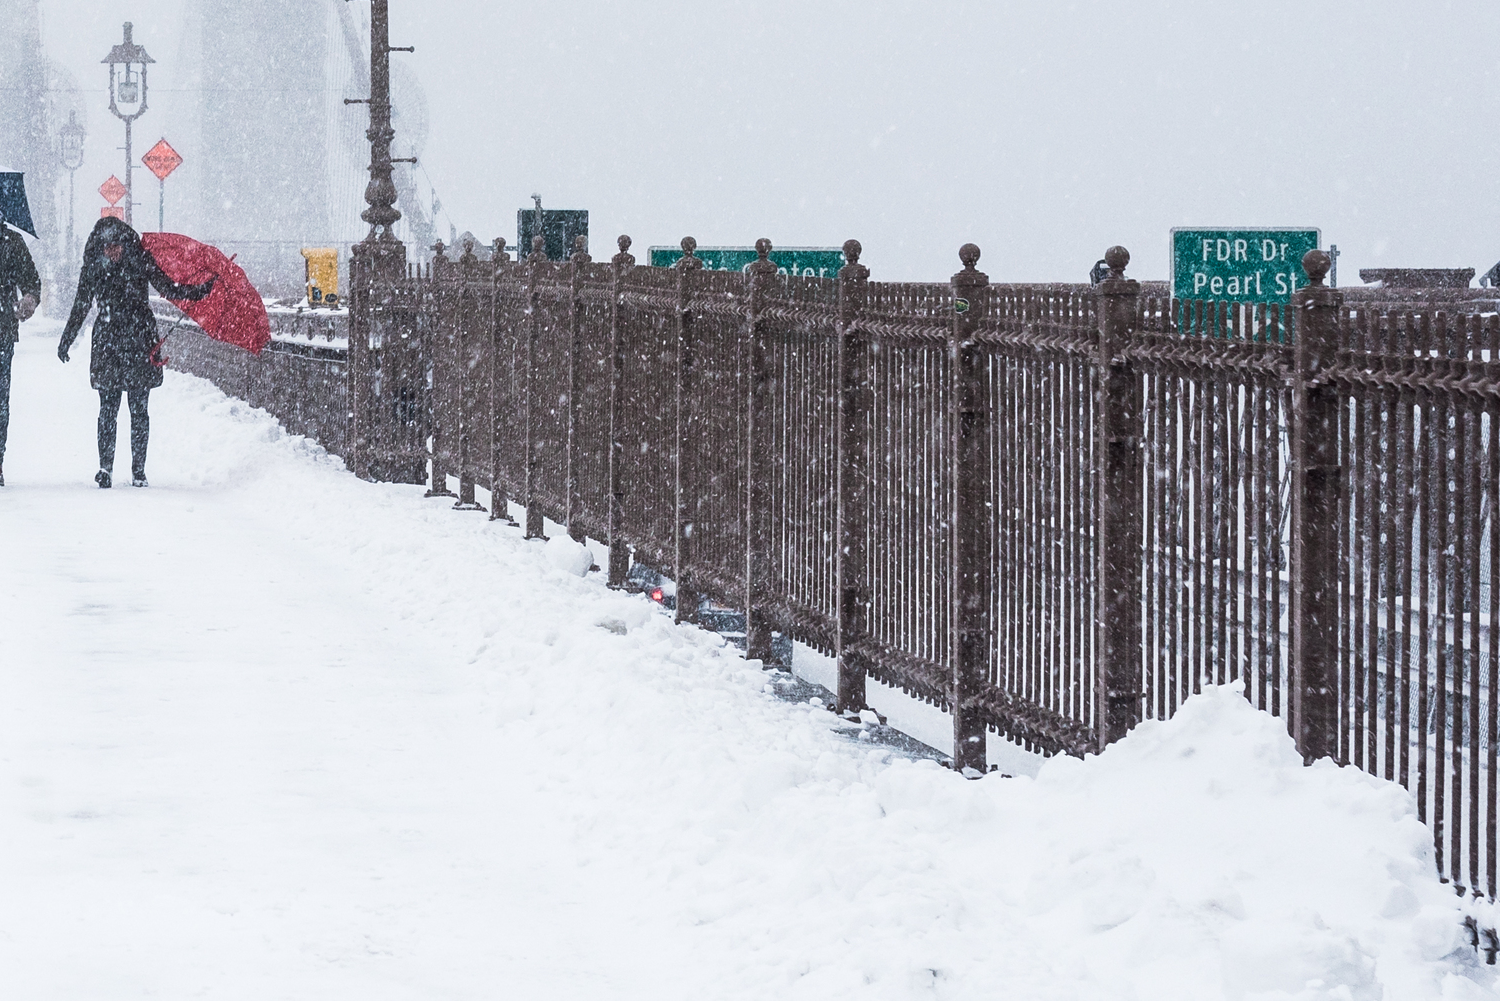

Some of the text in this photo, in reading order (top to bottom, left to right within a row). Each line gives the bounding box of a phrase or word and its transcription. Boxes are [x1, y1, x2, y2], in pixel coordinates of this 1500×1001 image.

[1202, 238, 1289, 262] FDR Dr
[1194, 271, 1298, 296] Pearl St
